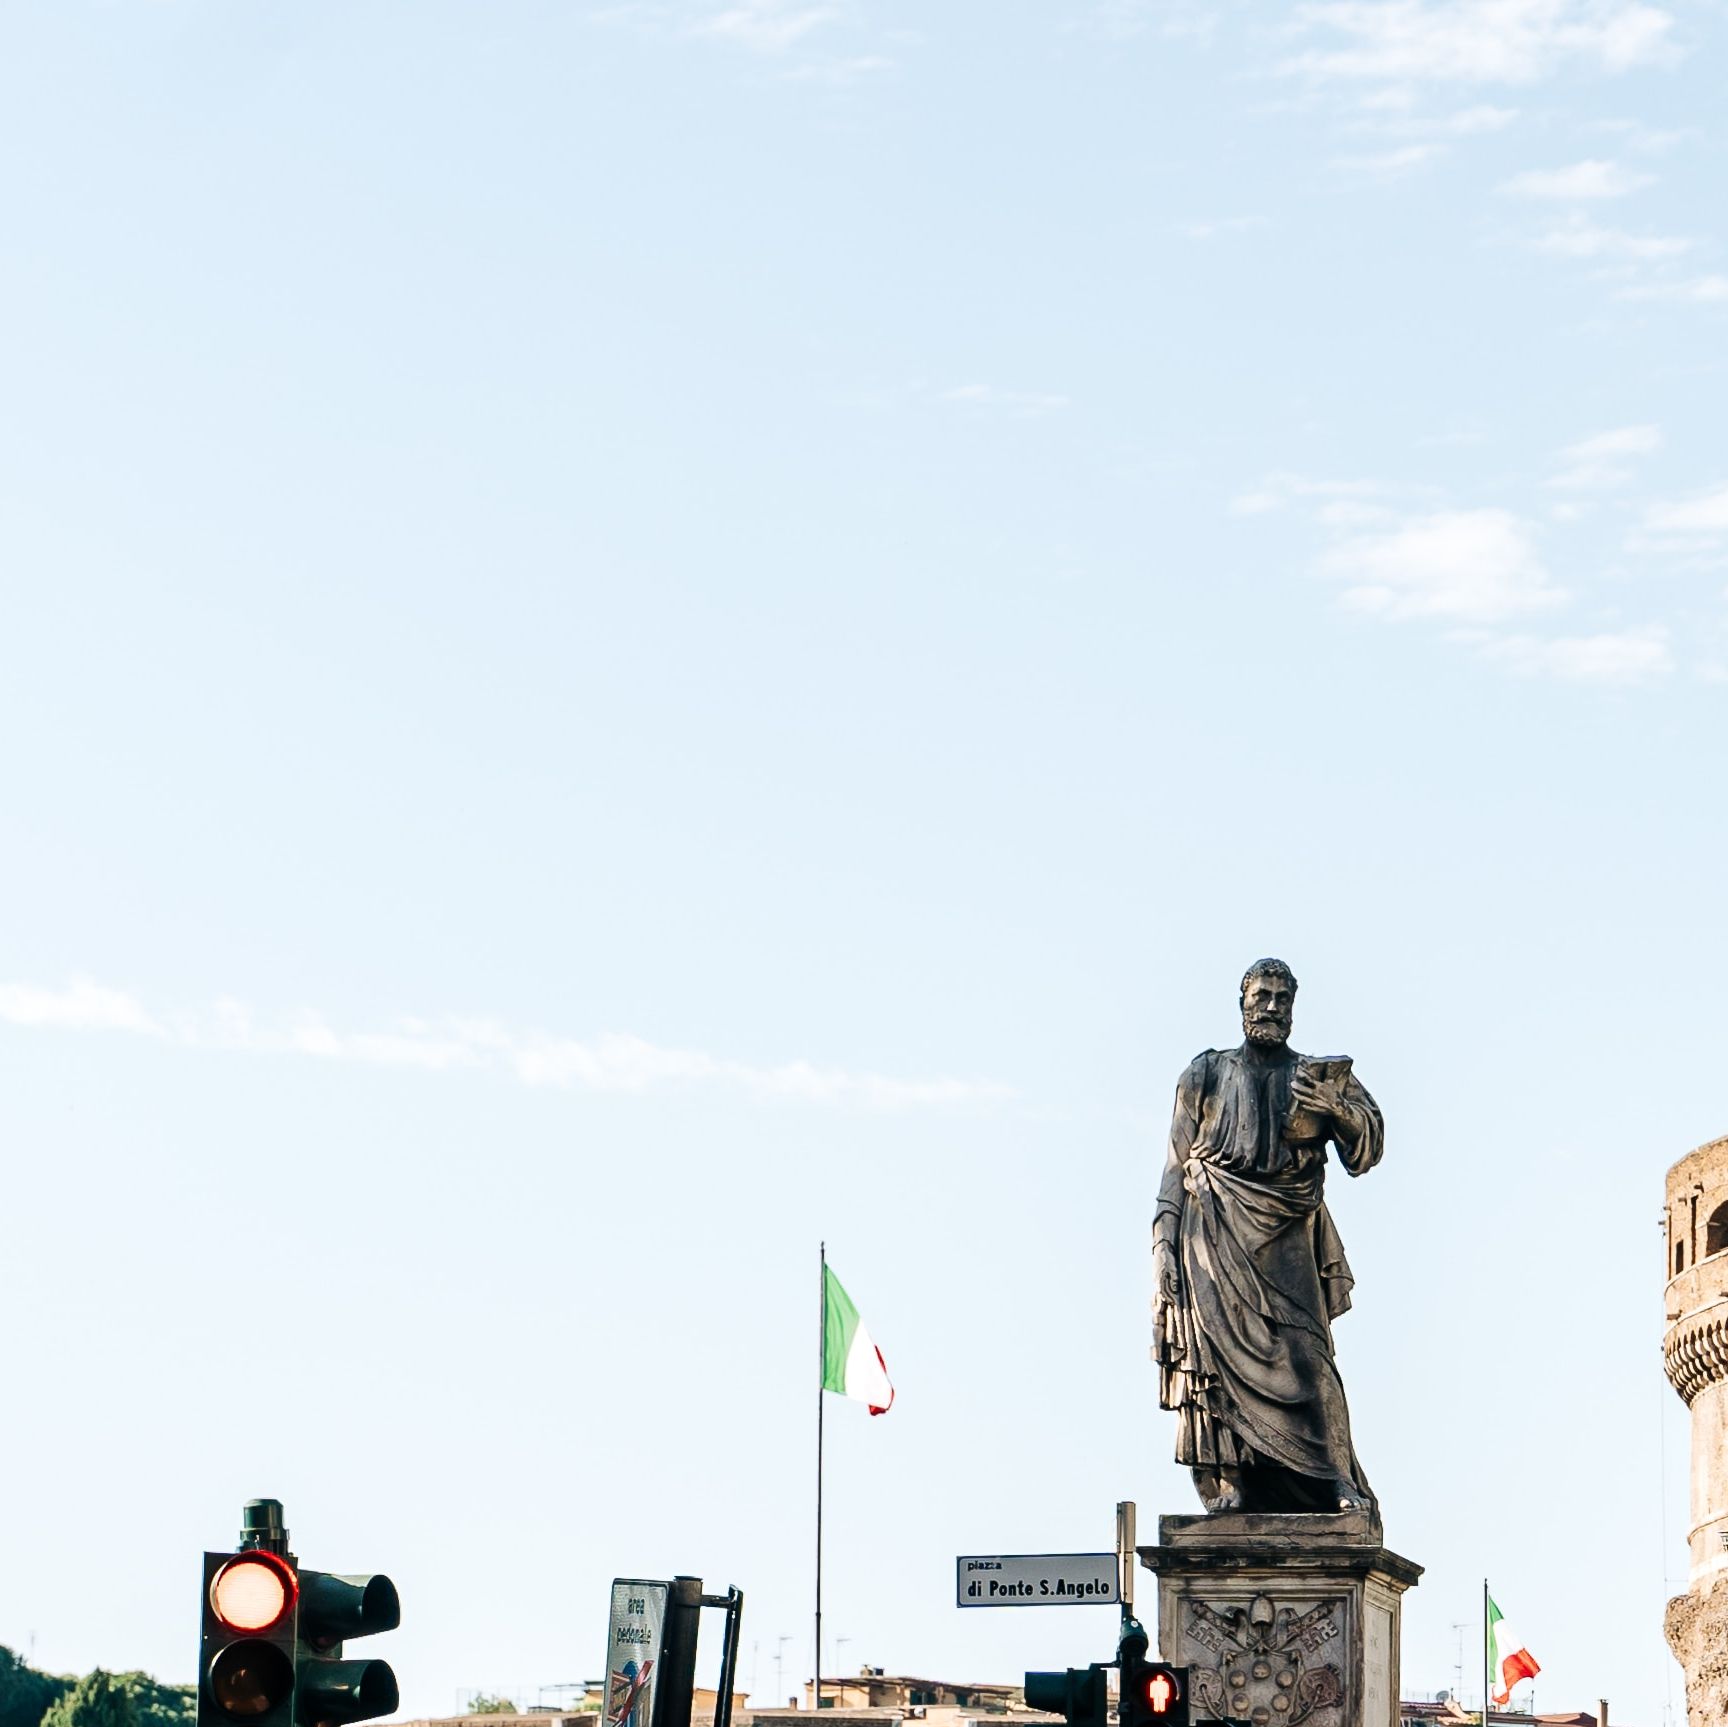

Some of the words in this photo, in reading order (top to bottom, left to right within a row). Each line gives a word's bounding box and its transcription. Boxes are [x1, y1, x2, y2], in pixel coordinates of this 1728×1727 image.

[967, 1560, 1002, 1572] piazza
[968, 1580, 982, 1597] di
[989, 1580, 1034, 1597] Ponte
[1040, 1579, 1110, 1599] S.Angelo
[628, 1598, 645, 1615] area
[617, 1622, 652, 1646] pedonale
